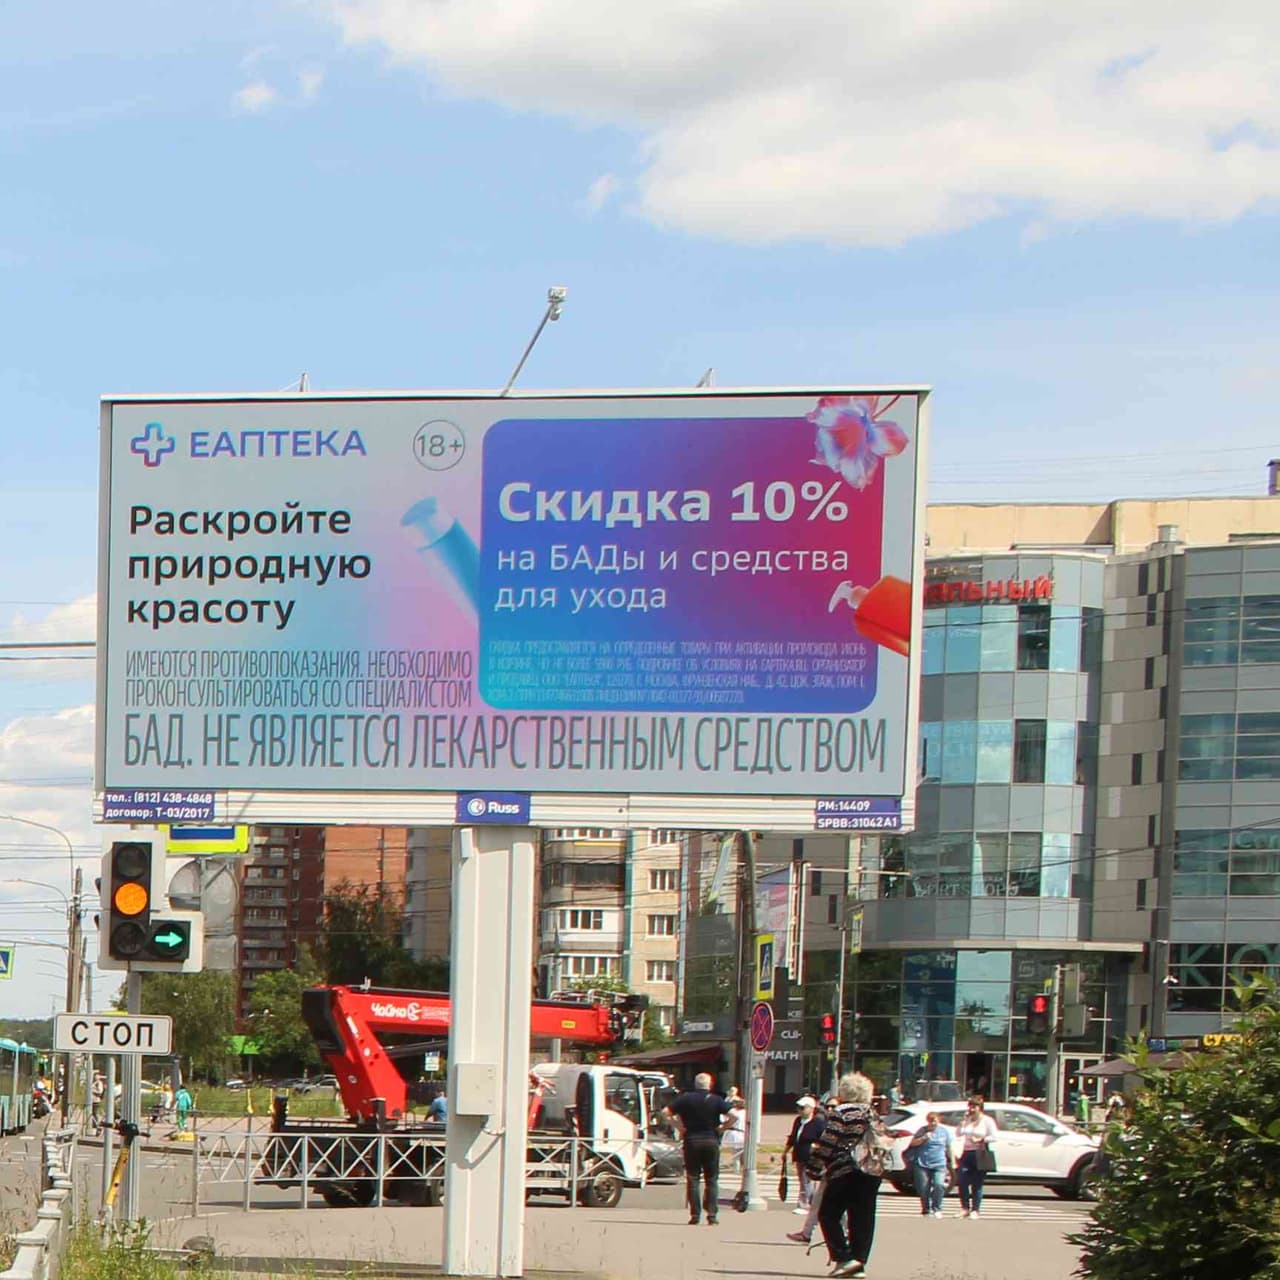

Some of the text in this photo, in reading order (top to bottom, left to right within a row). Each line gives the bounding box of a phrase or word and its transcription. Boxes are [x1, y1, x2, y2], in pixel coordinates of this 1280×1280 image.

[190, 430, 367, 457] ЕАПТЕКА
[417, 433, 463, 458] 18+
[498, 480, 849, 529] Скидка 10%
[129, 501, 352, 541] Раскройте
[128, 554, 372, 586] природную
[497, 545, 849, 576] на БАДы и средства
[127, 599, 296, 630] красоту
[495, 586, 667, 614] для ухода
[125, 650, 197, 678] ИМЕЮТСЯ
[201, 650, 364, 678] ПРОТИВОПОКАЗАНИЯ.
[368, 650, 472, 680] НЕОБХОДИМО
[125, 679, 318, 707] ПРОКОНСУЛЬТИРОВАТЬСЯ
[322, 680, 341, 707] СО
[345, 680, 472, 713] СПЕЦИАЛИСТОМ
[124, 713, 192, 769] БАД.
[203, 714, 240, 767] НЕ
[247, 714, 400, 768] ЯВЛЯЕТСЯ
[407, 714, 684, 772] ЛЕКАРСТВЕННЫМ
[694, 717, 886, 775] СРЕДСТВОМ
[134, 791, 160, 804] (812)
[162, 792, 212, 804] 438-4848
[488, 801, 520, 814] Russ
[105, 808, 153, 819] договор:
[71, 1020, 154, 1047] СТОП
